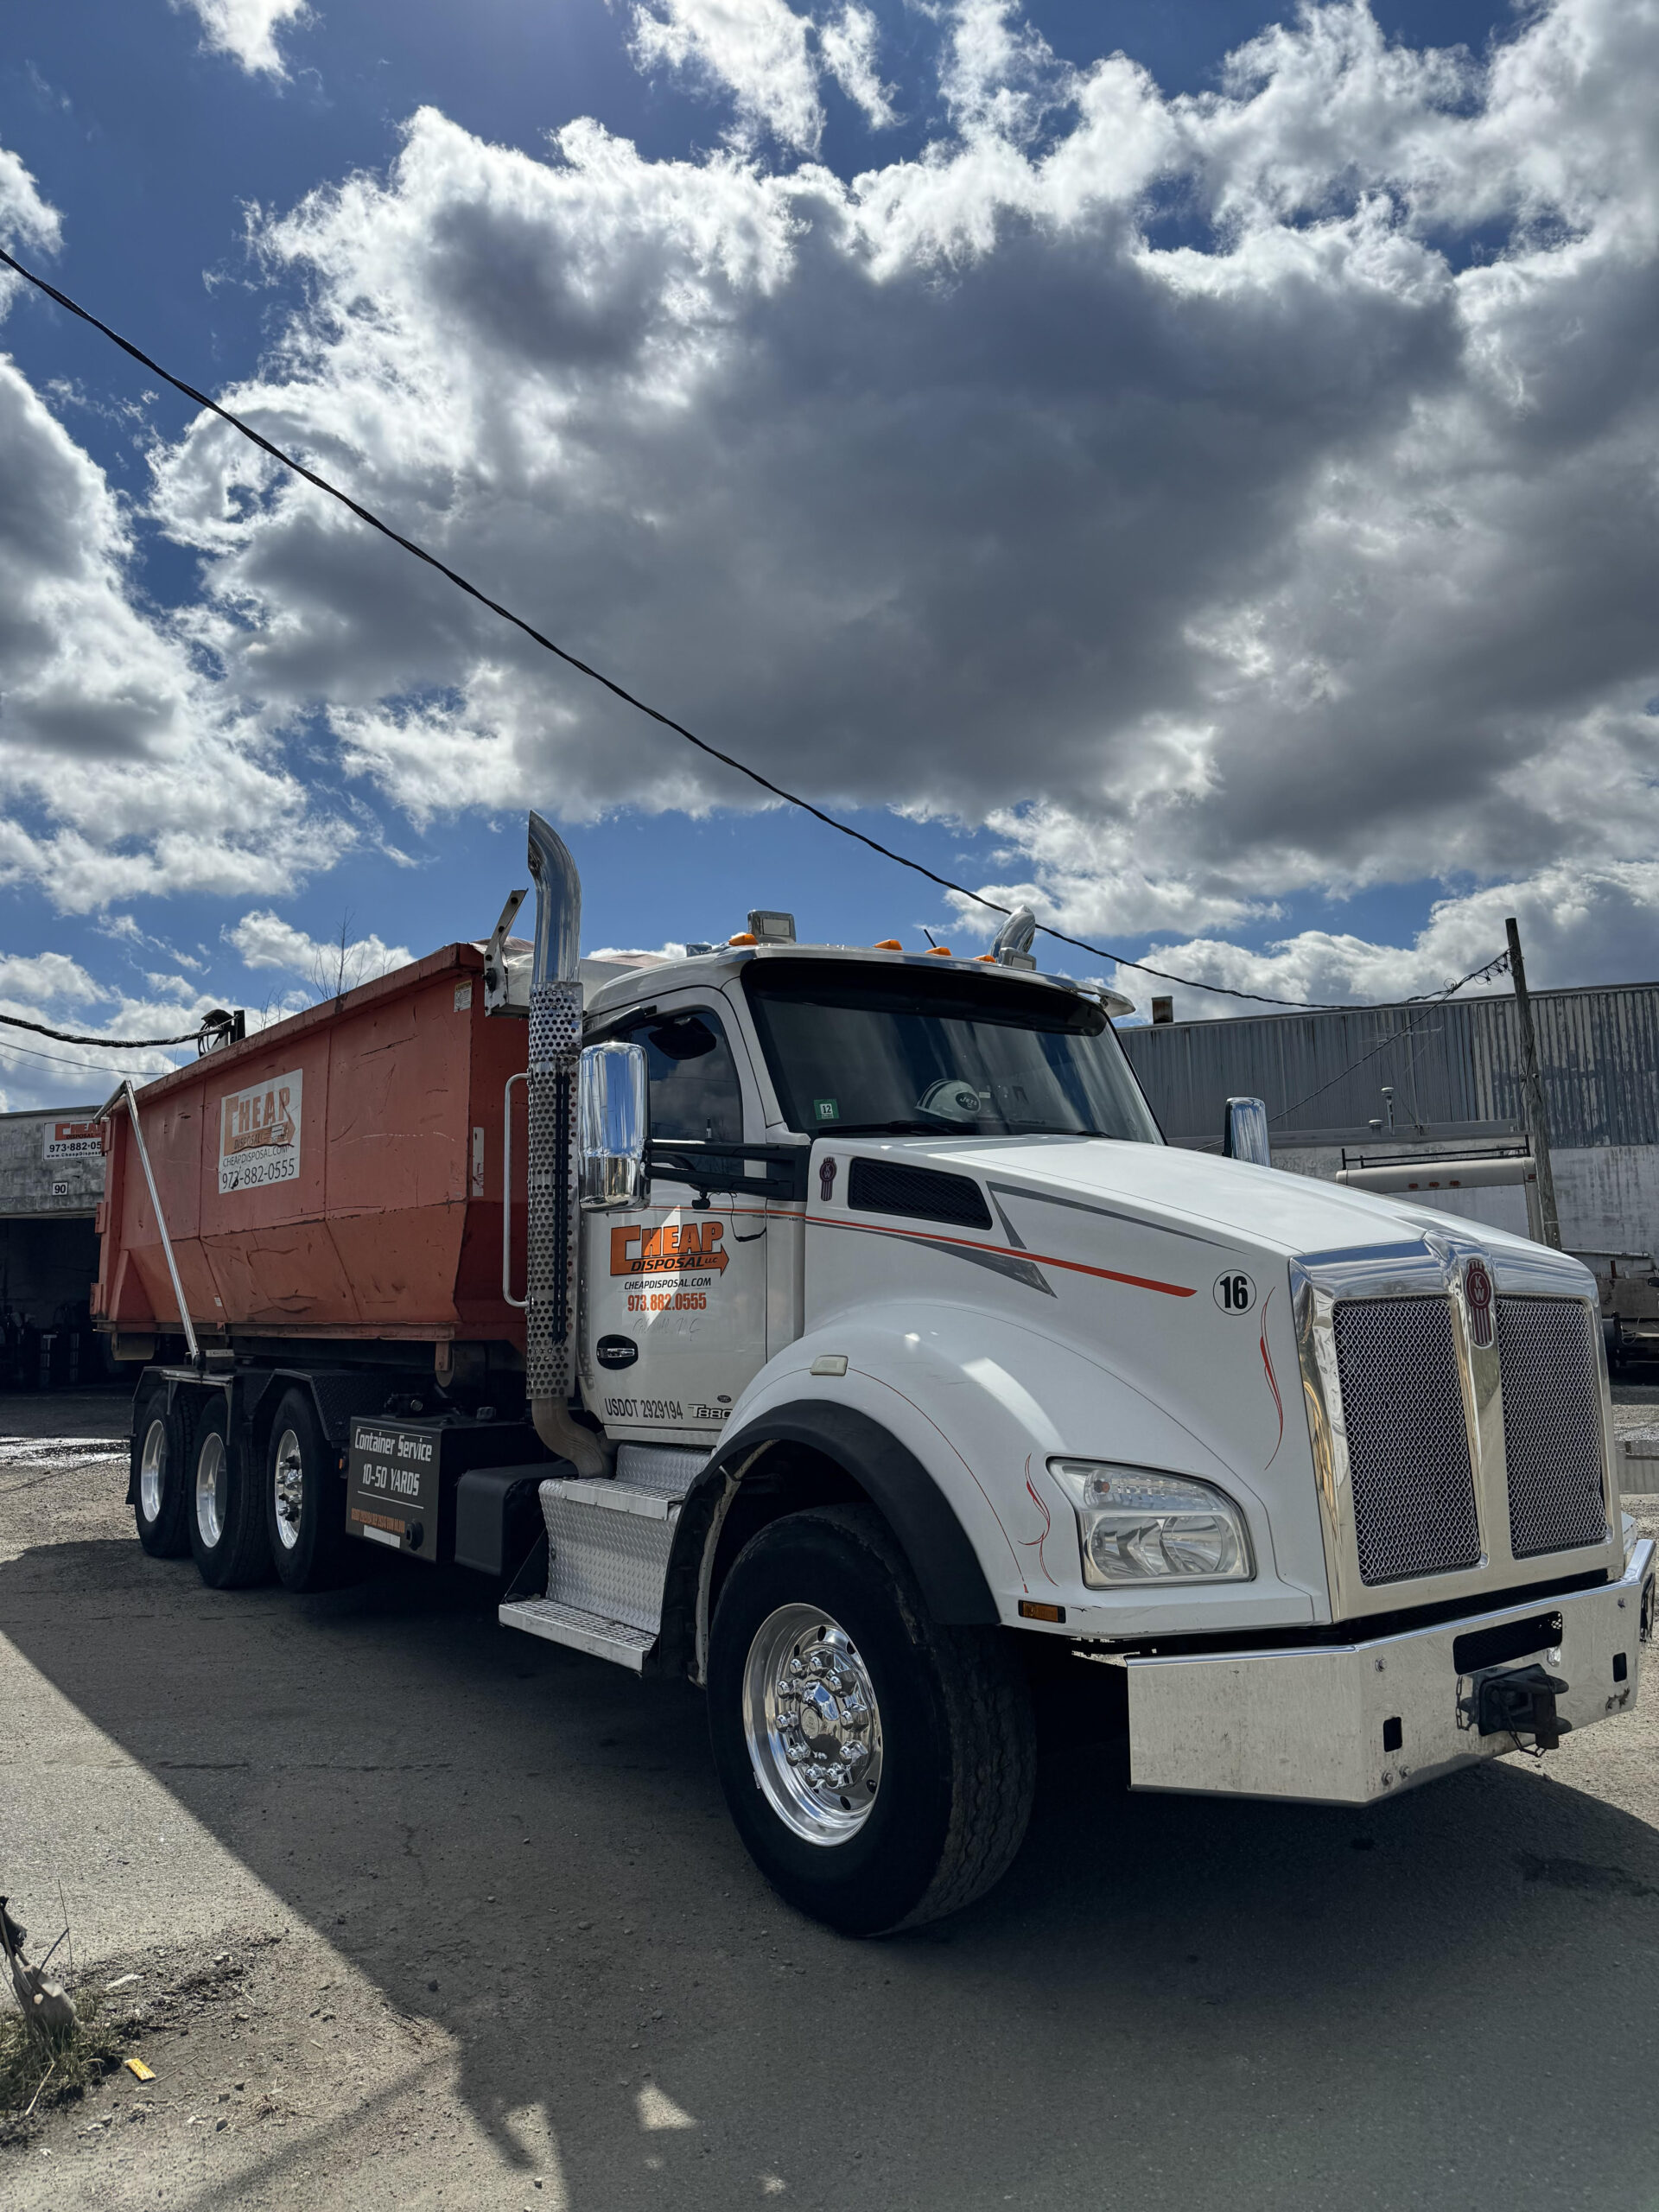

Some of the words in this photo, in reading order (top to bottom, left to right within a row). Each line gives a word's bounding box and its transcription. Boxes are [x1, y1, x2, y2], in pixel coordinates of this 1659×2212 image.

[822, 1105, 832, 1114] 12
[224, 1087, 291, 1156] CHEAP
[54, 1185, 66, 1194] 90
[610, 1222, 723, 1275] CHEAP
[631, 1256, 705, 1272] DISPOSAL
[624, 1278, 711, 1290] CHEAPDISPOSAL.COM
[1219, 1275, 1249, 1309] 16
[627, 1293, 707, 1311] 973.882.0555
[604, 1398, 639, 1418] USDOT
[640, 1400, 683, 1420] 2929194
[354, 1427, 396, 1455] Container
[397, 1434, 433, 1462] Service
[363, 1464, 387, 1489] 10-50
[391, 1468, 420, 1497] YARDS
